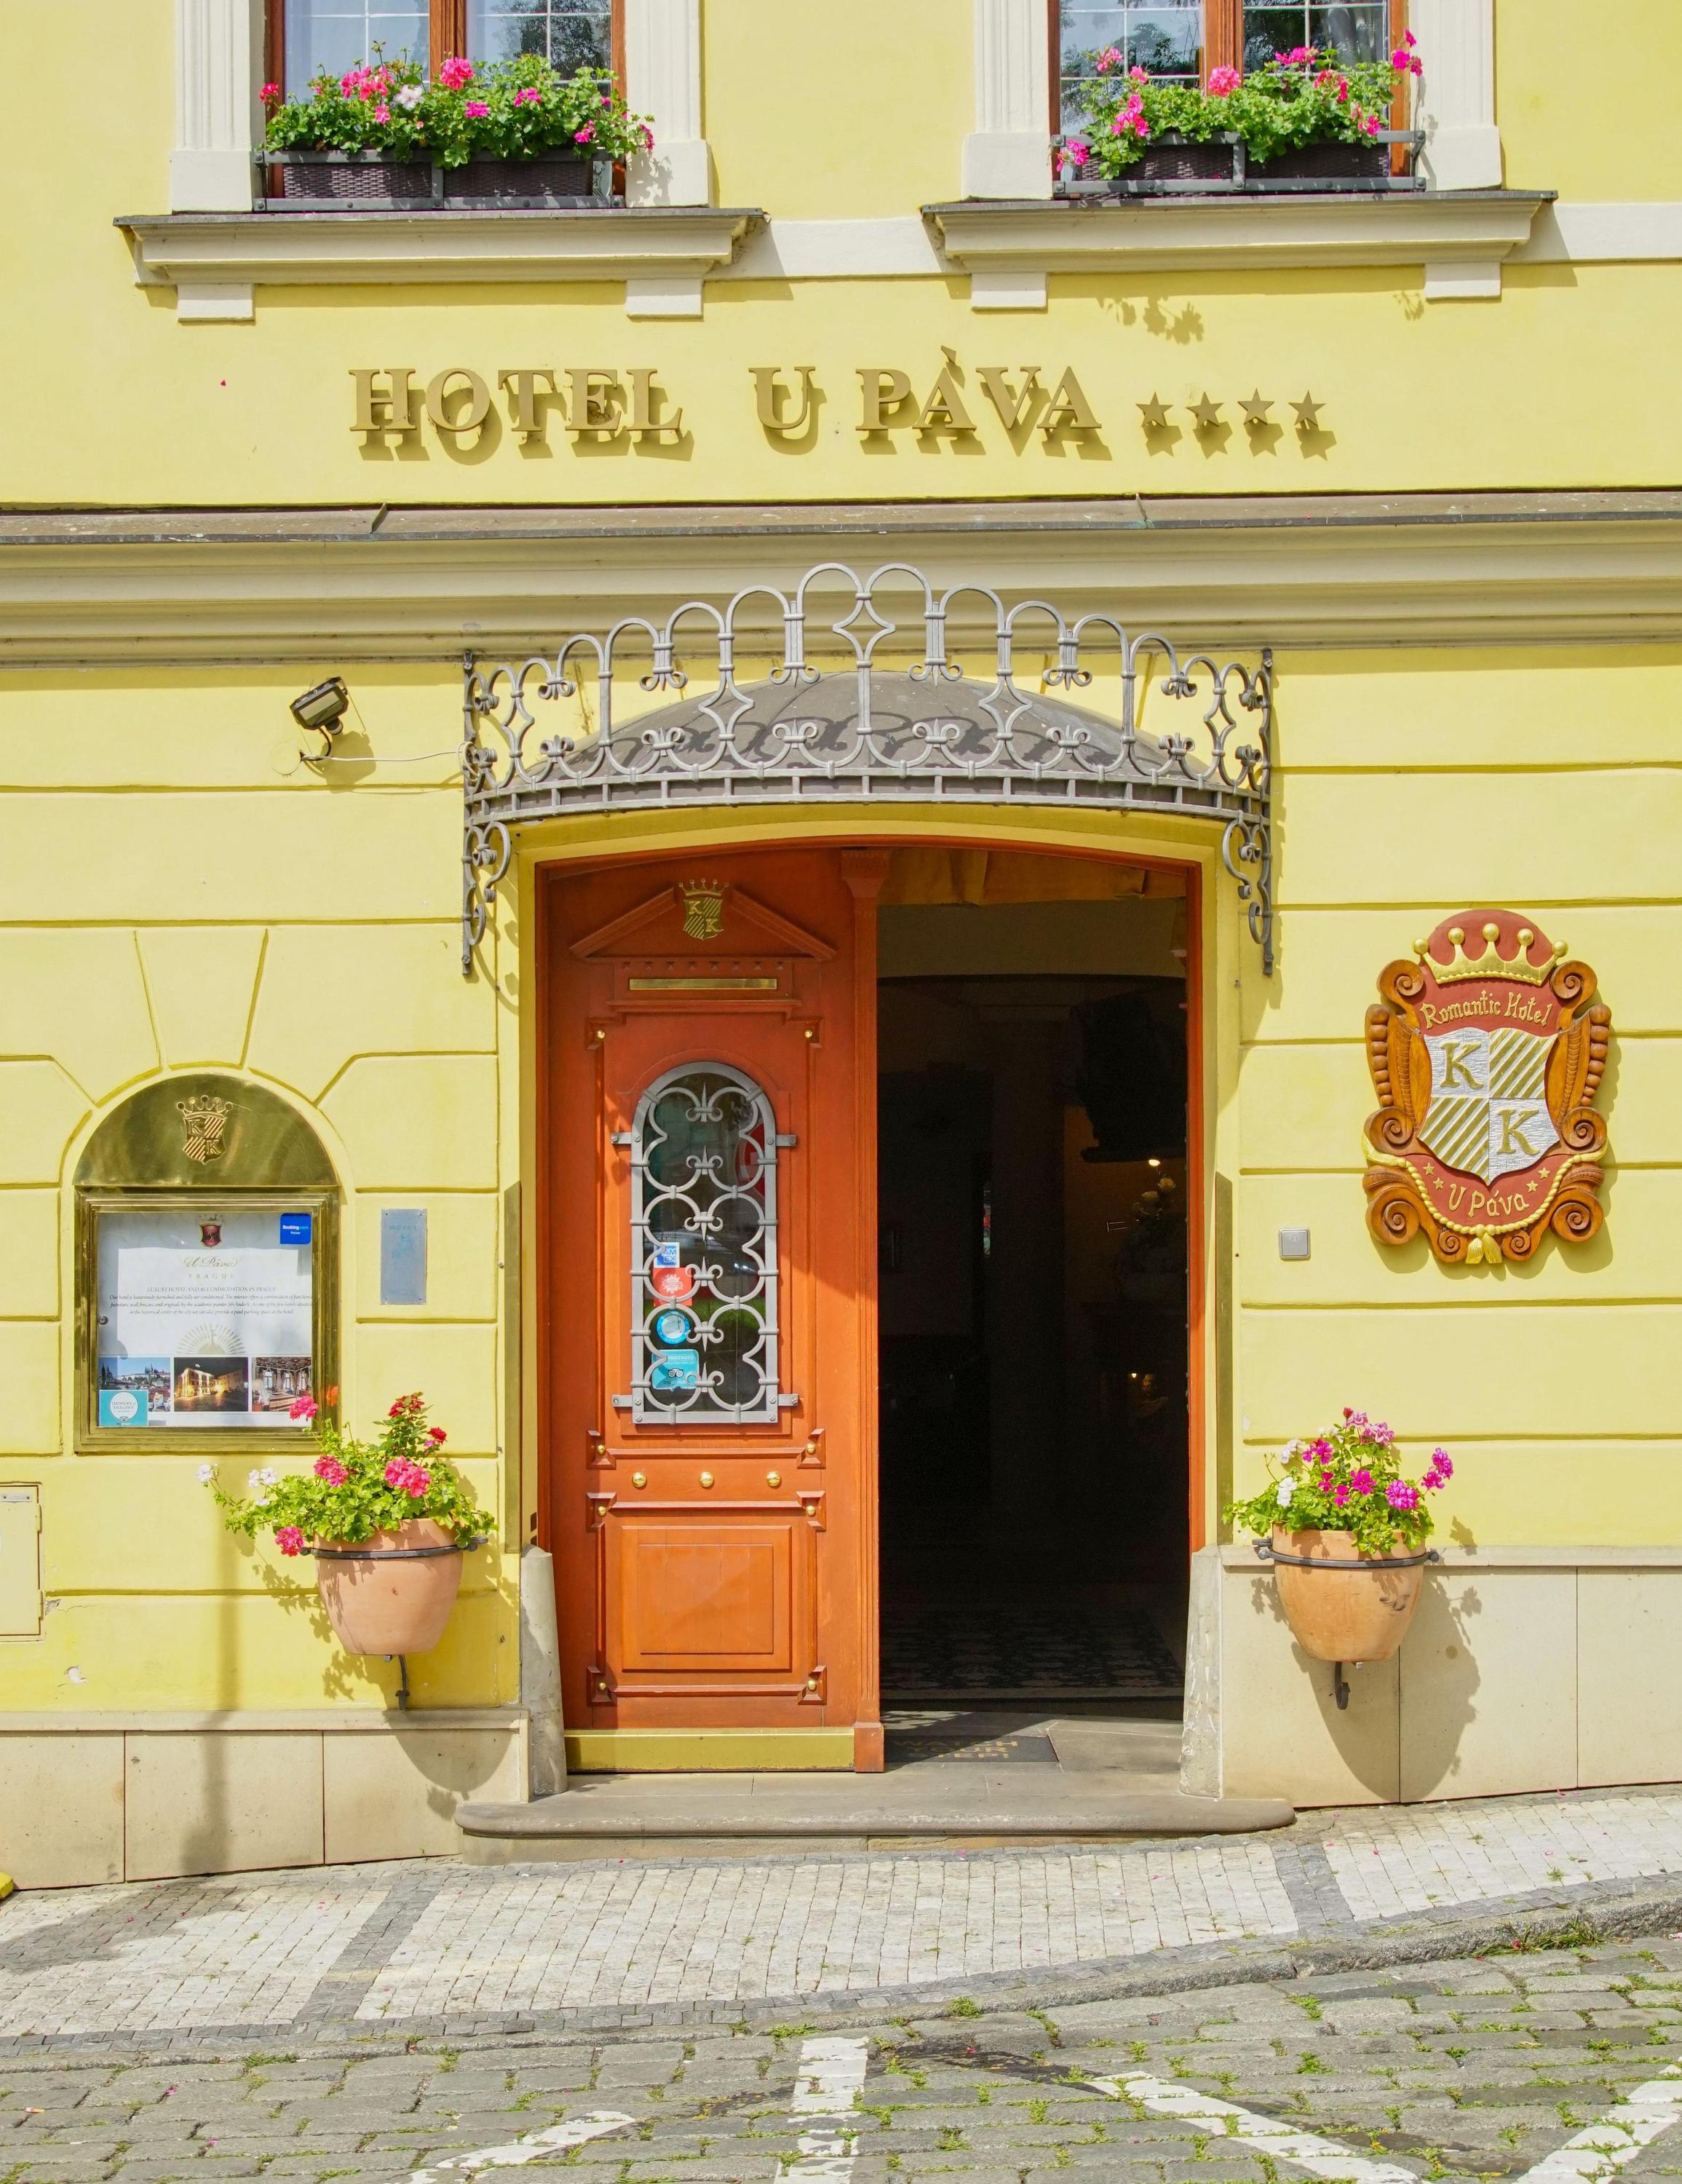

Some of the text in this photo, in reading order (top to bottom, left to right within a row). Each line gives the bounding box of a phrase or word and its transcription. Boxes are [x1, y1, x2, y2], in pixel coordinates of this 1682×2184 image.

[348, 367, 683, 432] HOTEL
[748, 366, 816, 430] U
[689, 901, 702, 914] K
[705, 918, 720, 932] K
[1420, 989, 1553, 1029] Romantic Hotel
[1440, 1040, 1484, 1089] K
[187, 1119, 203, 1133] K
[1496, 1107, 1540, 1155] K
[206, 1139, 221, 1155] K
[1448, 1184, 1530, 1218] U Páva
